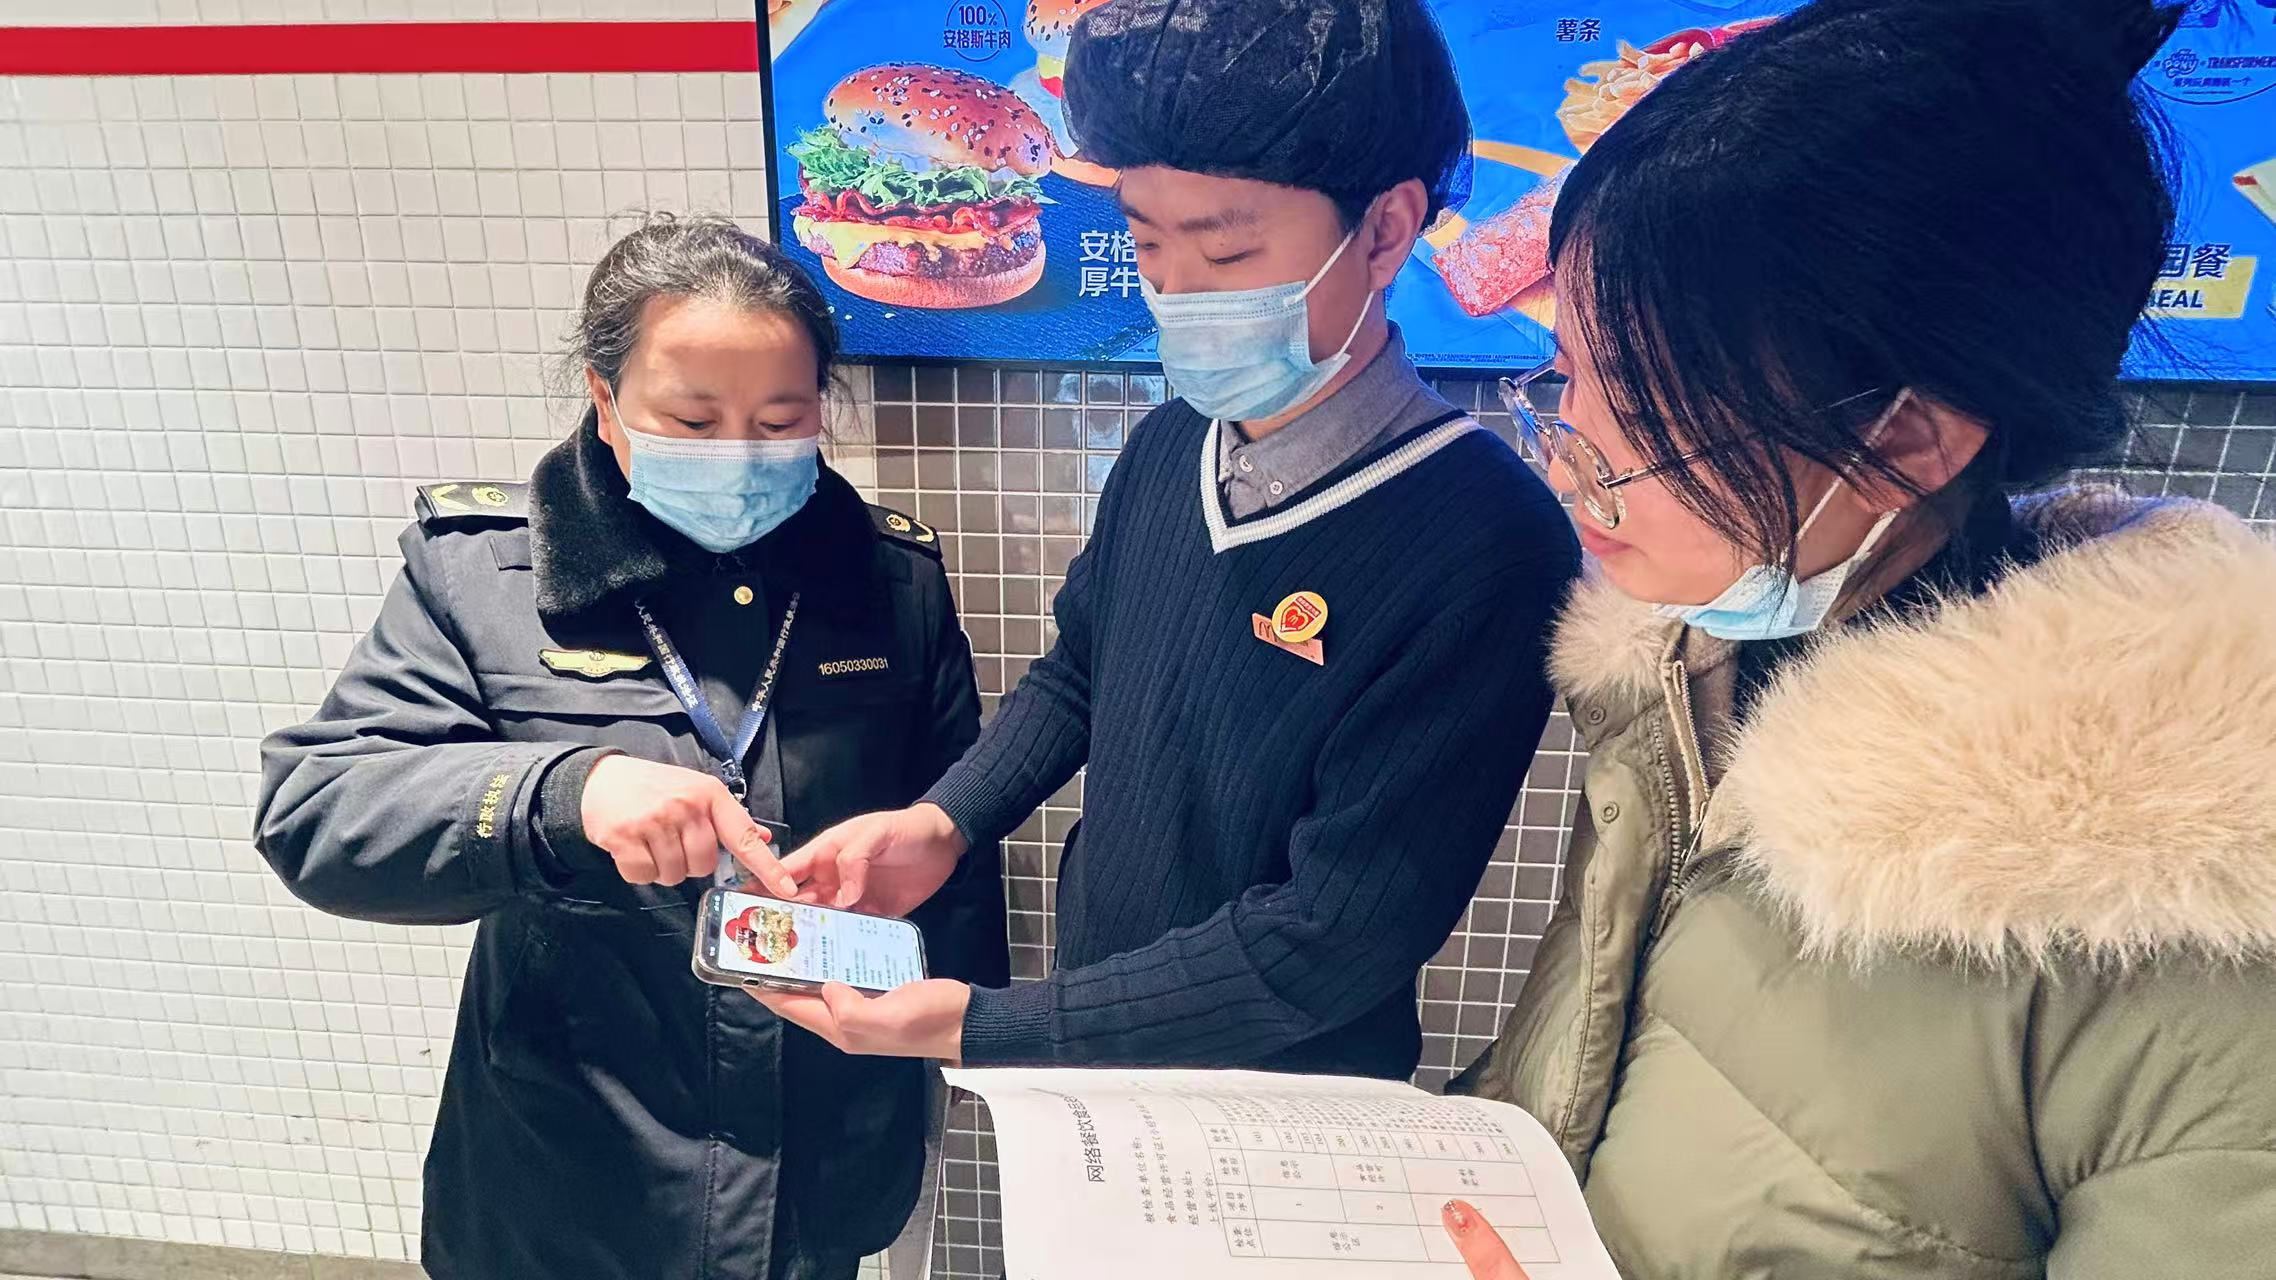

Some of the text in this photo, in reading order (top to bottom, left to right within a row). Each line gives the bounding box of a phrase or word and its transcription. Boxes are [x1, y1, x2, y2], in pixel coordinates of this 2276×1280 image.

[958, 5, 997, 26] 100%
[943, 29, 1011, 49] 安格斯牛肉
[1555, 18, 1601, 42] 薯条
[1079, 230, 1138, 263] 安格
[1078, 267, 1145, 298] 厚牛
[818, 657, 889, 676] 16050330031
[476, 774, 511, 838] 行政执法
